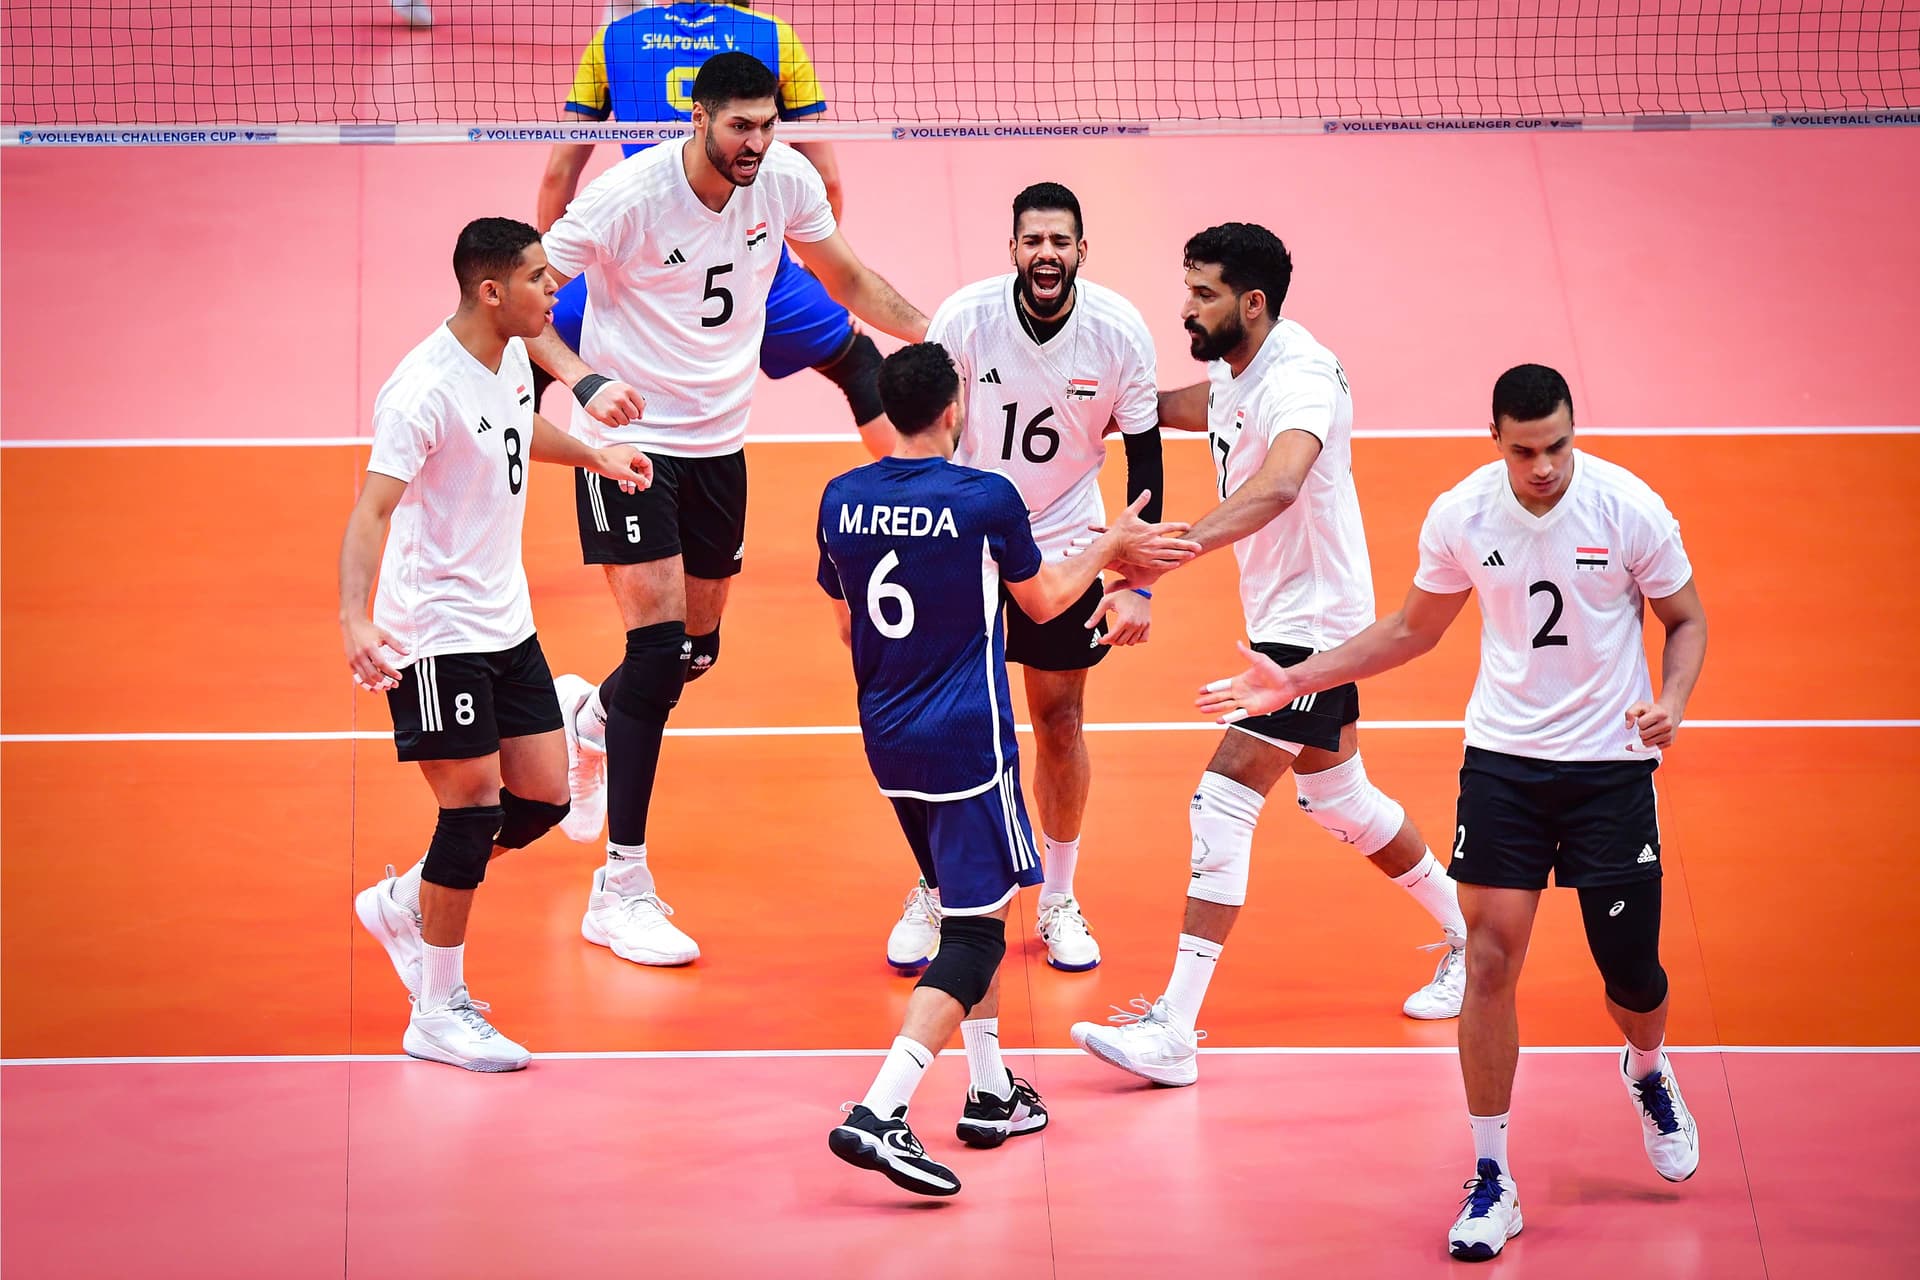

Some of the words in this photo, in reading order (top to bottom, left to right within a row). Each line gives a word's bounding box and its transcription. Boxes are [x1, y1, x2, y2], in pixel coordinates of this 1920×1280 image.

[641, 33, 720, 50] SHAPOVAL
[724, 34, 740, 50] V.
[37, 132, 118, 143] VOLLEYBALL
[121, 131, 207, 142] CHALLENGER
[210, 130, 237, 141] CUP
[486, 129, 567, 140] VOLLEYBALL
[570, 129, 655, 139] CHALLENGER
[658, 129, 685, 139] CUP
[910, 127, 991, 137] VOLLEYBALL
[993, 126, 1080, 136] CHALLENGER
[1082, 125, 1109, 135] CUP
[1343, 122, 1423, 131] VOLLEYBALL
[1426, 120, 1512, 130] CHALLENGER
[1515, 119, 1543, 129] CUP
[1790, 115, 1871, 125] VOLLEYBALL
[701, 262, 734, 328] 5
[1001, 401, 1060, 464] 16
[504, 427, 523, 496] 8
[625, 515, 642, 544] 5
[838, 503, 960, 539] M.REDA
[867, 548, 915, 640] 6
[1529, 579, 1569, 649] 2
[455, 692, 476, 726] 8
[1454, 824, 1466, 860] 2
